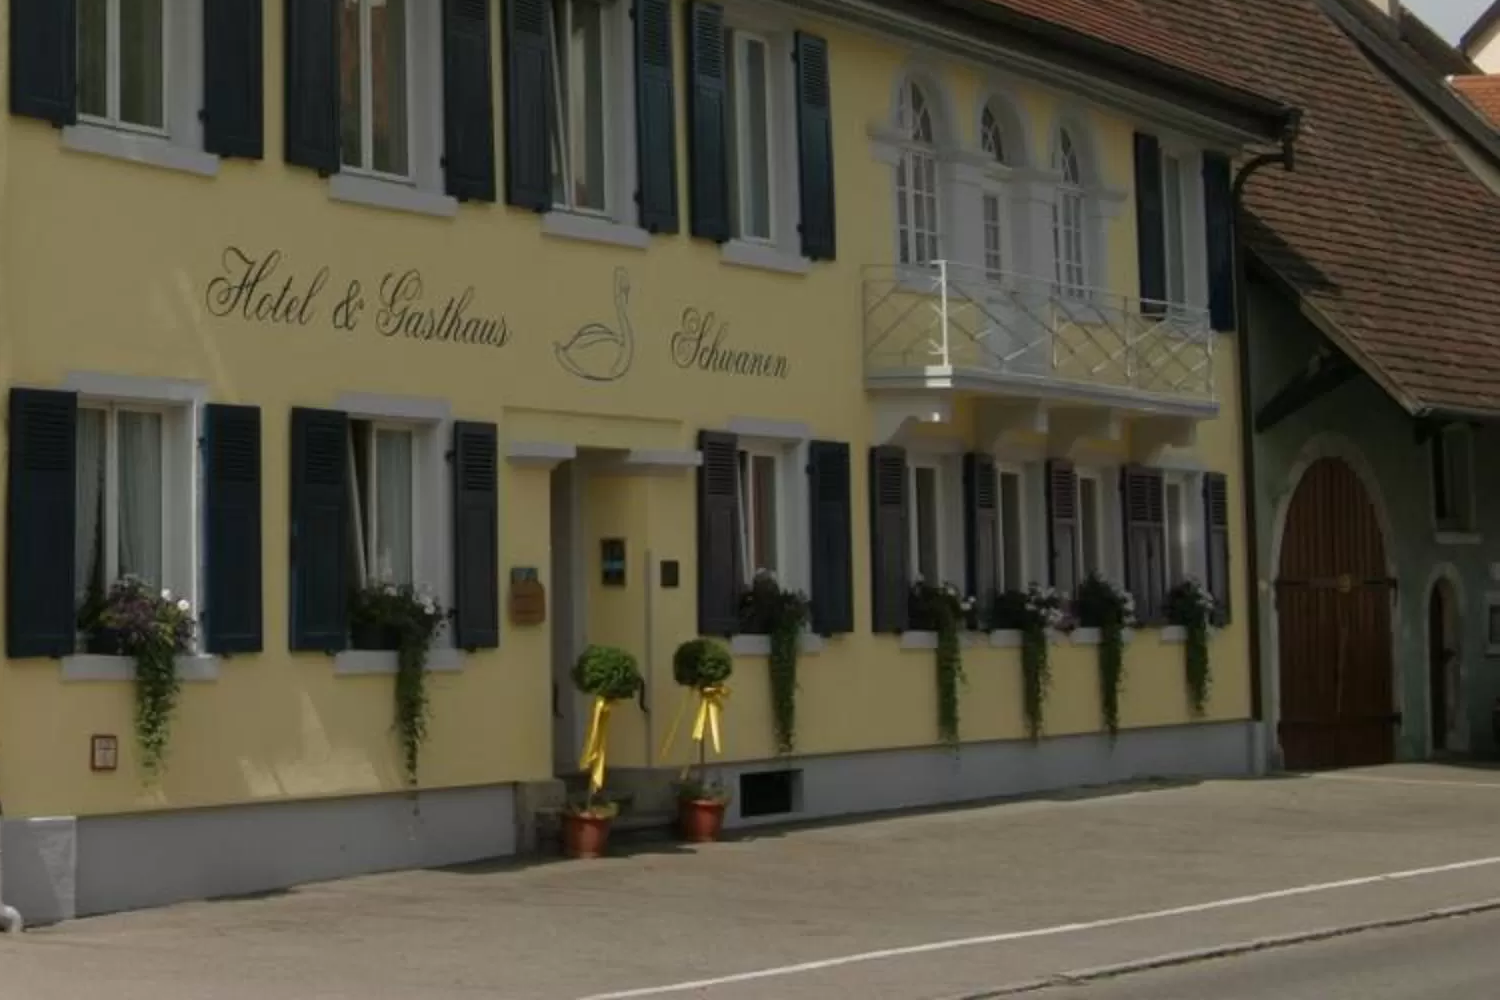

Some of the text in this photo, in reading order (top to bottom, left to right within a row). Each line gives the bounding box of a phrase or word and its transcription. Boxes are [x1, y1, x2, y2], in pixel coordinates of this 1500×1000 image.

[205, 245, 789, 380] Hotel & Gasthaus Schwanen
